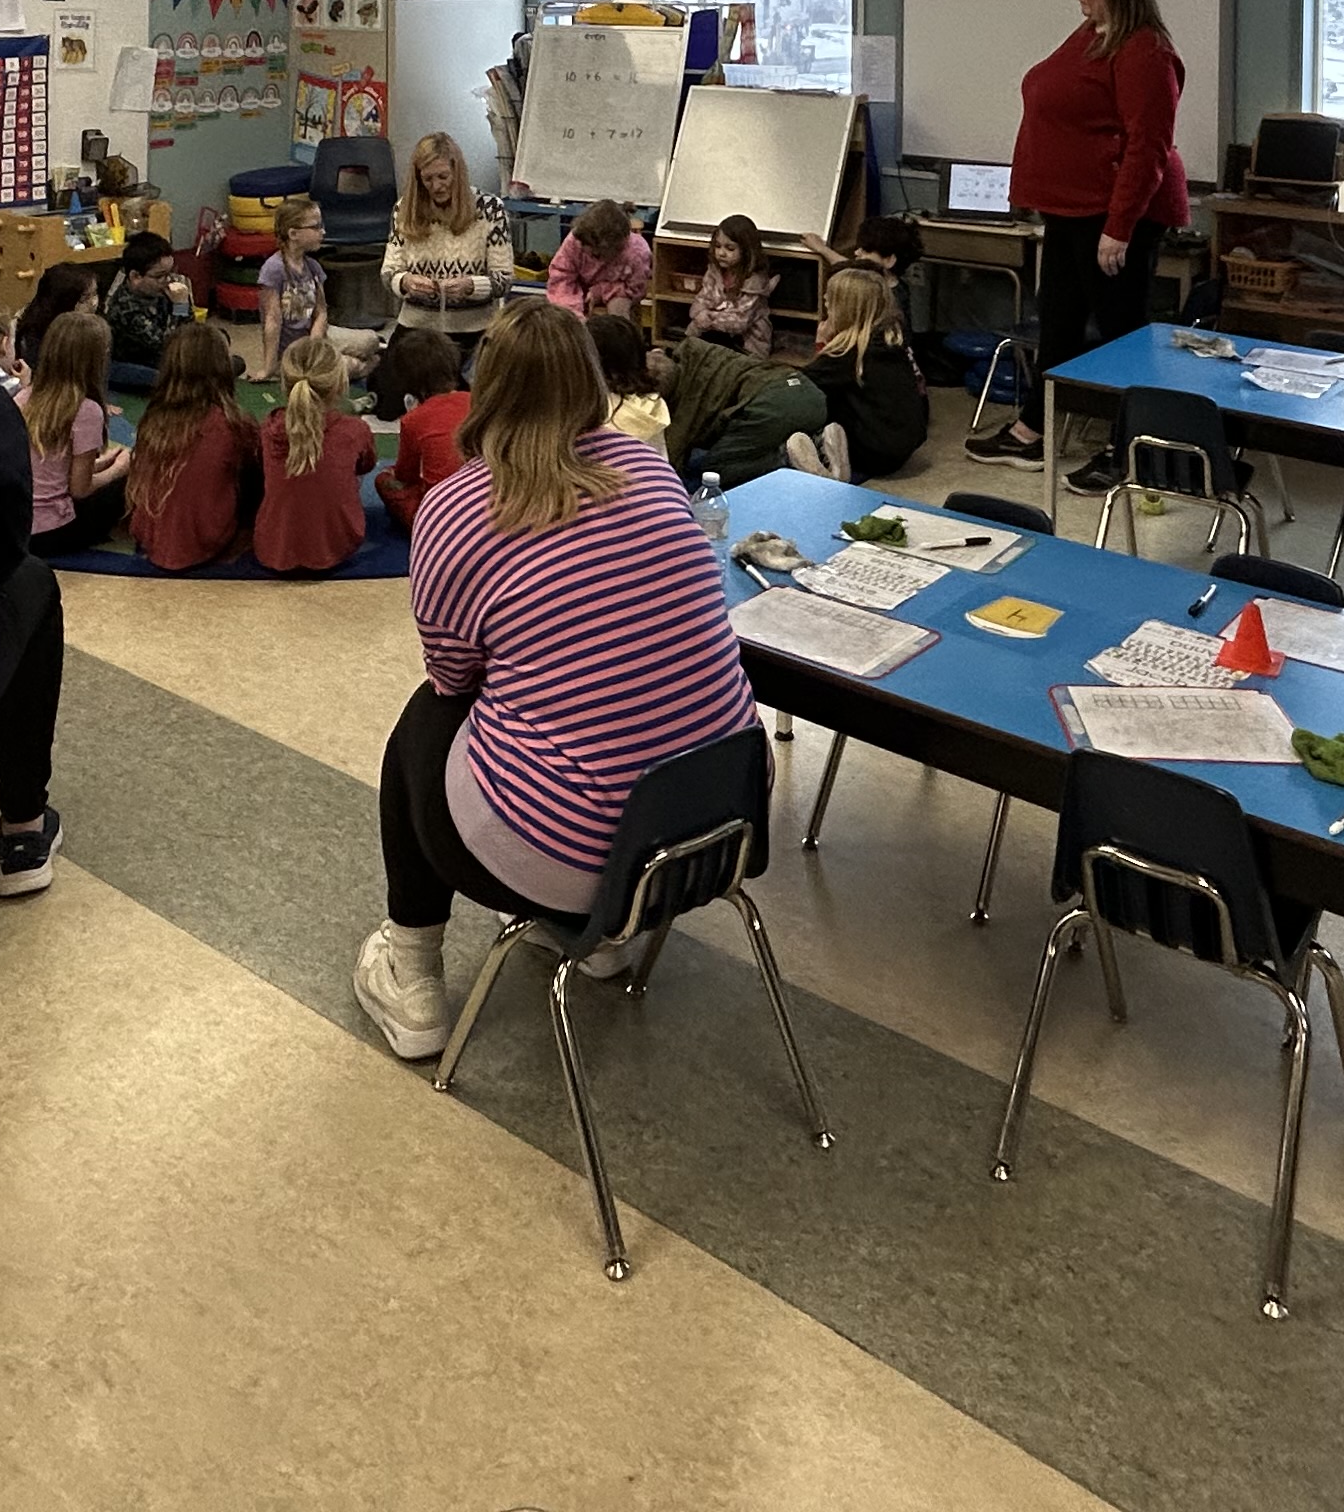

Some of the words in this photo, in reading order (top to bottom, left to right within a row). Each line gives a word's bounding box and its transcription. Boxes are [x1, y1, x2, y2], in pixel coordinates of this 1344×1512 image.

[565, 71, 577, 82] 10
[594, 72, 601, 82] 6
[562, 128, 575, 140] 10
[606, 128, 617, 140] 7
[1127, 665, 1188, 687] Jacob
